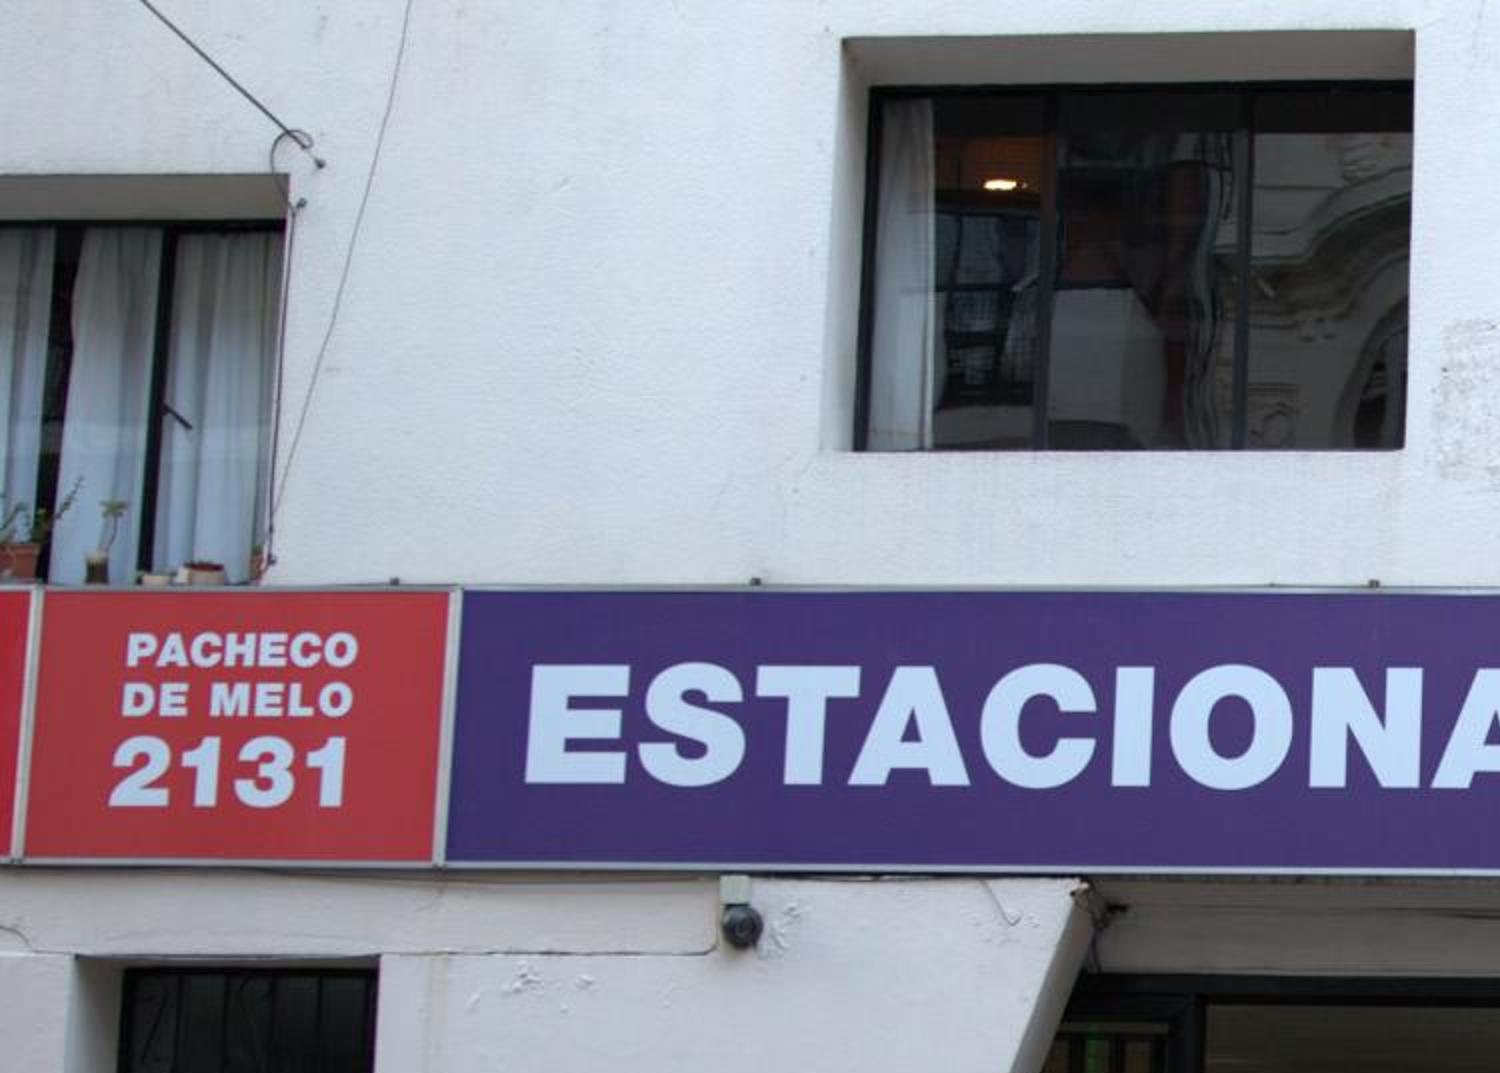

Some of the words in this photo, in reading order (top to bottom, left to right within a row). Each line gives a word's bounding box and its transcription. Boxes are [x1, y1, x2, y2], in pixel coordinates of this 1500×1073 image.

[128, 631, 358, 668] PACHECO
[122, 682, 189, 717] DE
[210, 681, 353, 717] MELO
[109, 735, 346, 808] 2131
